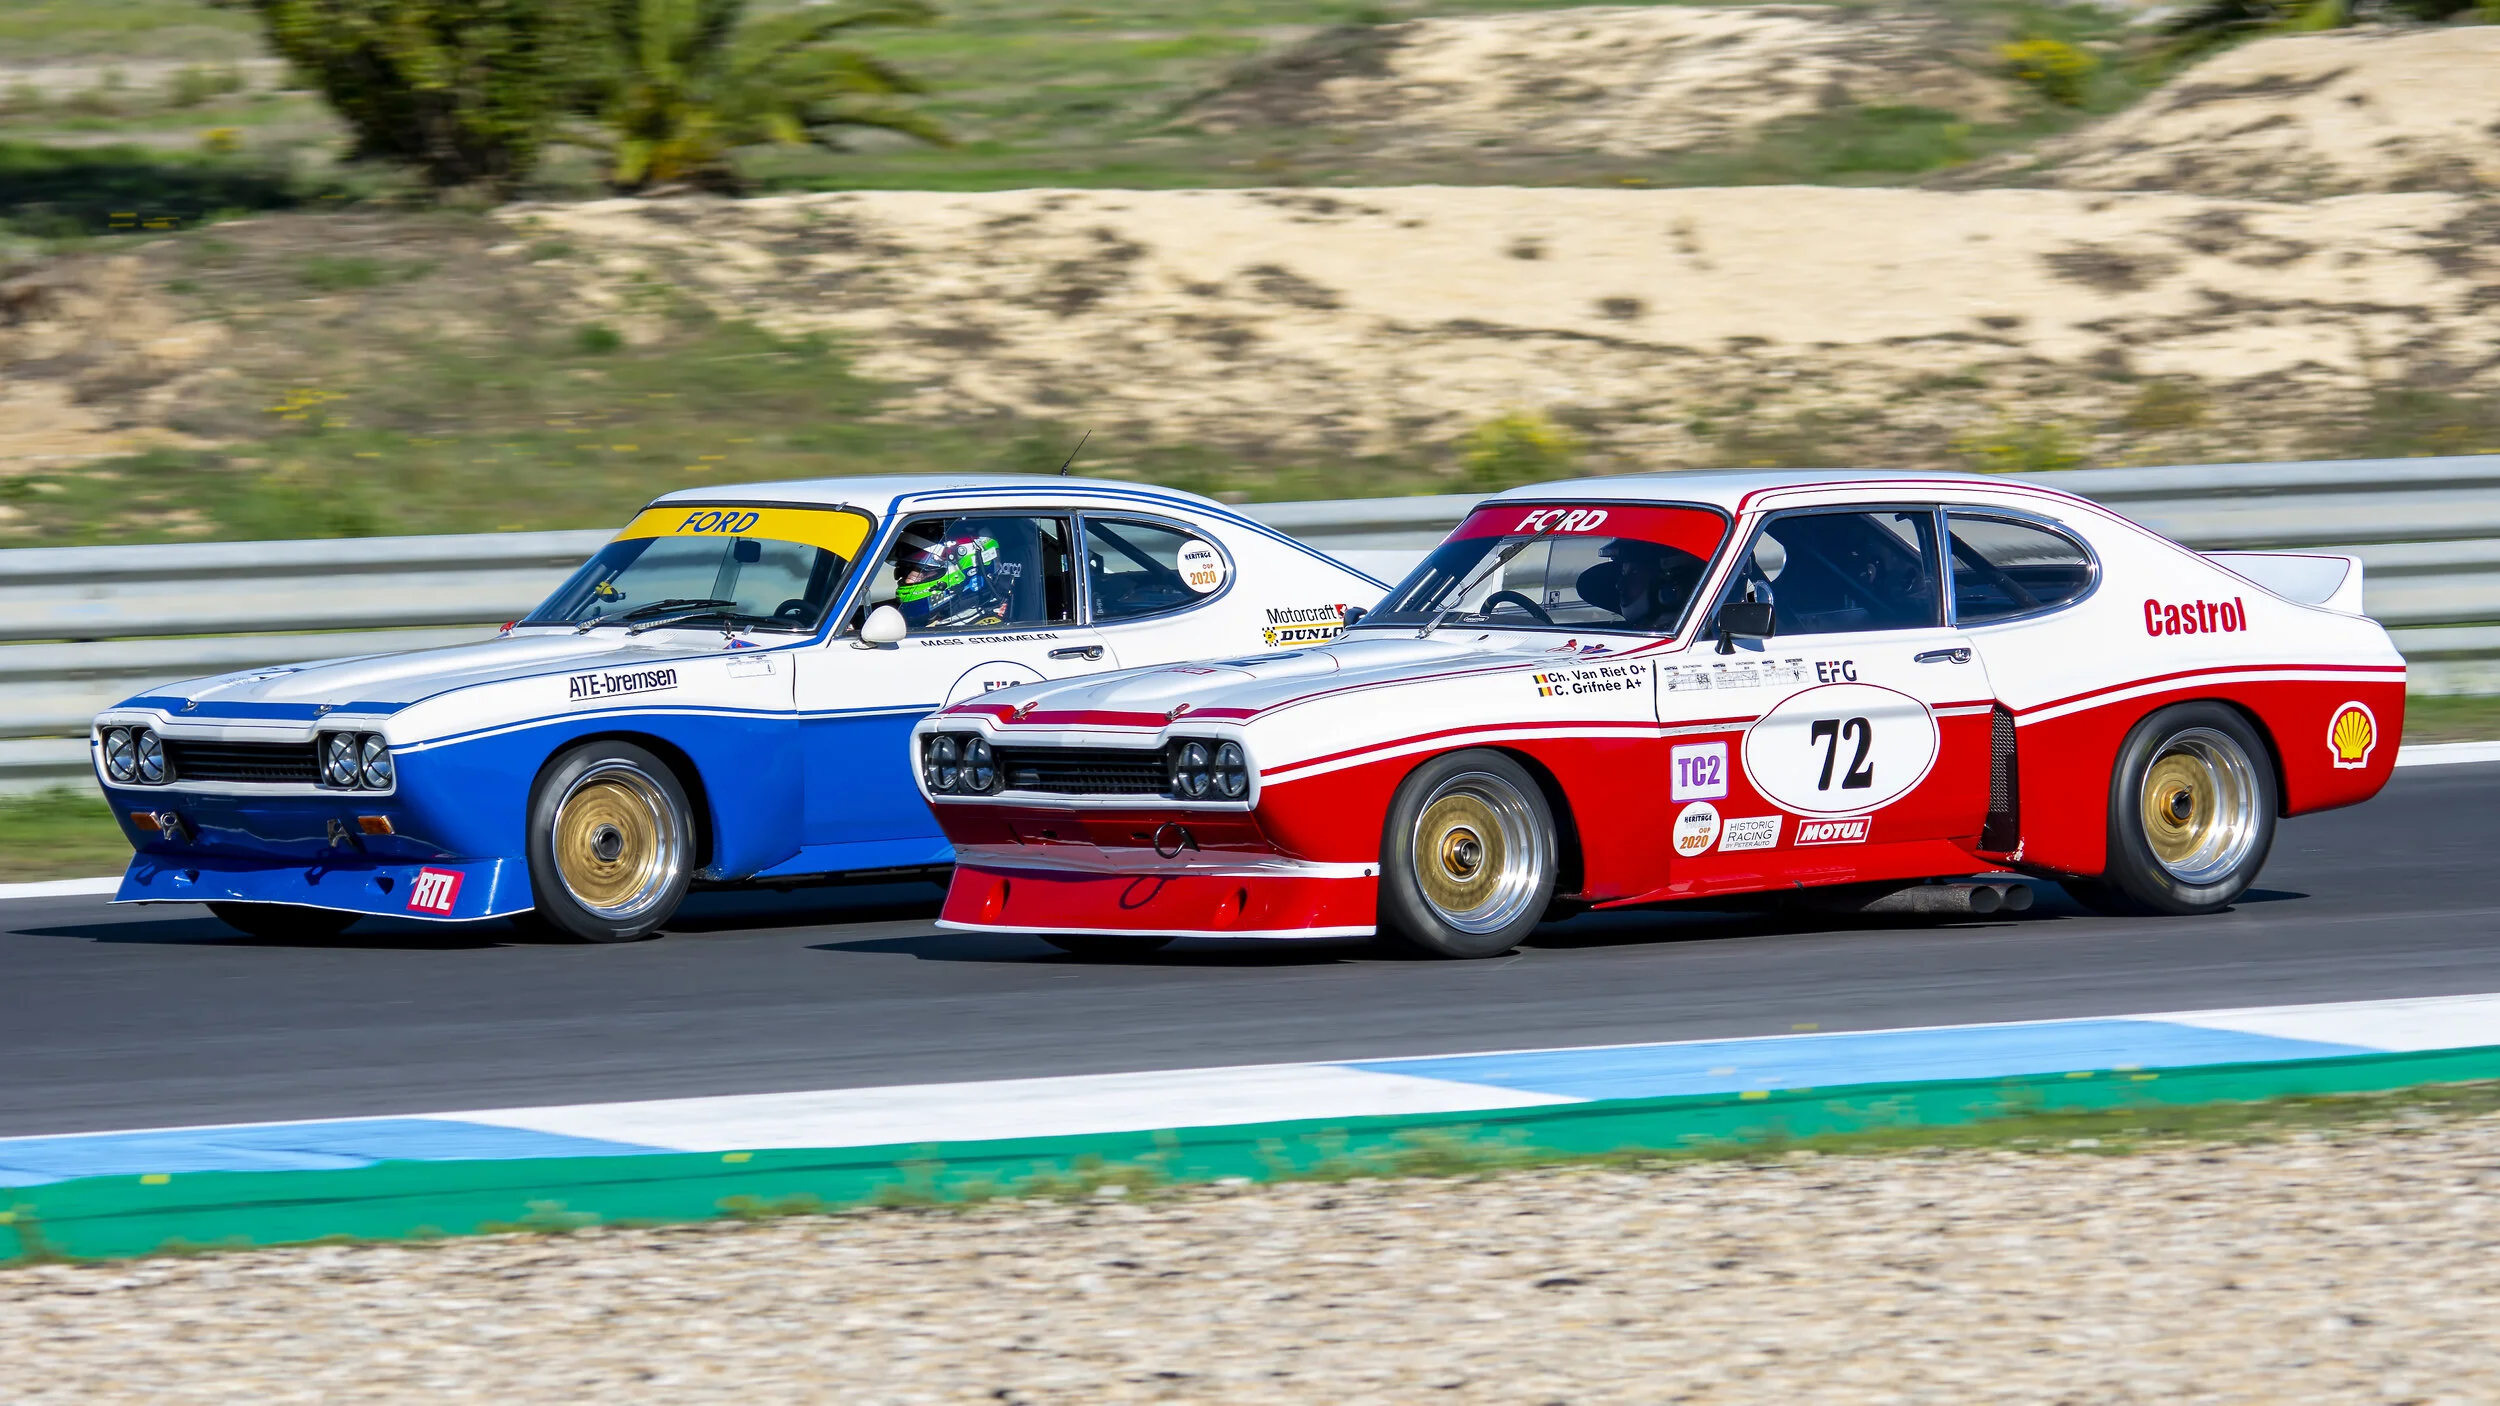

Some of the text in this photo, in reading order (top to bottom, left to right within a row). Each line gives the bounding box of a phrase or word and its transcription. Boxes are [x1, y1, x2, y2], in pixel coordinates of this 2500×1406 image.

[676, 511, 760, 533] FORD
[1513, 509, 1608, 532] FORD
[1190, 570, 1217, 585] 2020
[1266, 604, 1337, 624] Motorcraft
[2143, 596, 2247, 637] Castrol
[920, 632, 1060, 647] MASS STOMMELEN
[1548, 672, 1570, 683] Ch.
[1571, 670, 1598, 680] Van
[1599, 666, 1627, 678] Riet
[1815, 660, 1857, 683] EFG
[569, 668, 678, 699] ATE-bremsen
[1554, 678, 1642, 696] C. Grifnée A+
[1811, 716, 1874, 791] 72
[1678, 755, 1721, 787] TC2
[1684, 814, 1713, 823] HERITAGE
[1729, 820, 1775, 832] HISTORIC
[1727, 829, 1773, 842] RACING
[1800, 822, 1865, 841] MOTUL
[1680, 834, 1709, 849] 2020
[411, 871, 455, 911] RTL
